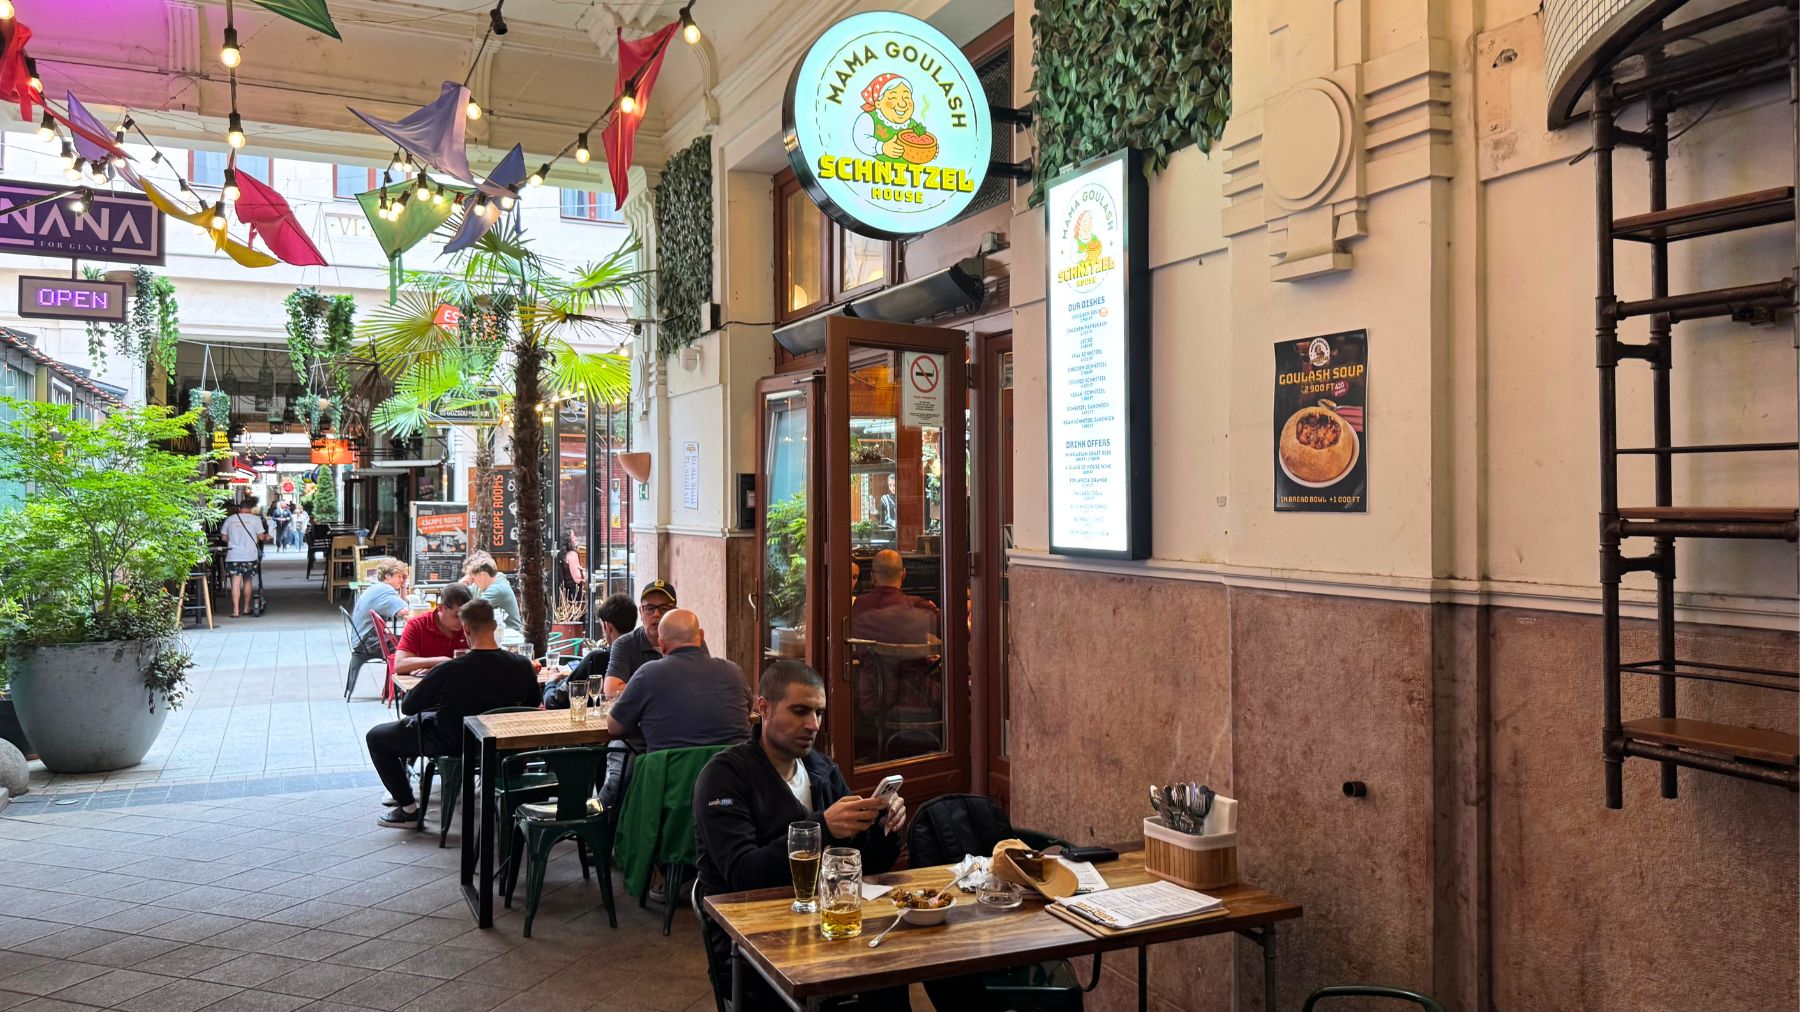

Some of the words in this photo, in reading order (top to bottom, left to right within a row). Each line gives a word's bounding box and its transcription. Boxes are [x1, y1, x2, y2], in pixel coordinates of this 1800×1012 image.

[826, 44, 879, 104] MAMA
[884, 41, 967, 128] GOULASH
[818, 155, 975, 192] SCHNITZEL
[871, 188, 924, 204] HOUSE
[0, 198, 143, 244] NANA
[1062, 200, 1080, 239] MAMA
[1082, 190, 1113, 231] GOULASH
[70, 244, 108, 252] GENTS
[39, 288, 108, 309] OPEN
[1082, 296, 1105, 308] DISHES
[1280, 368, 1330, 385] GOULASH
[1333, 364, 1364, 379] SOUP
[1066, 440, 1086, 448] DRINK
[1086, 438, 1111, 448] OFFERS
[493, 475, 504, 508] ROOMS
[493, 510, 504, 546] ESCAPE
